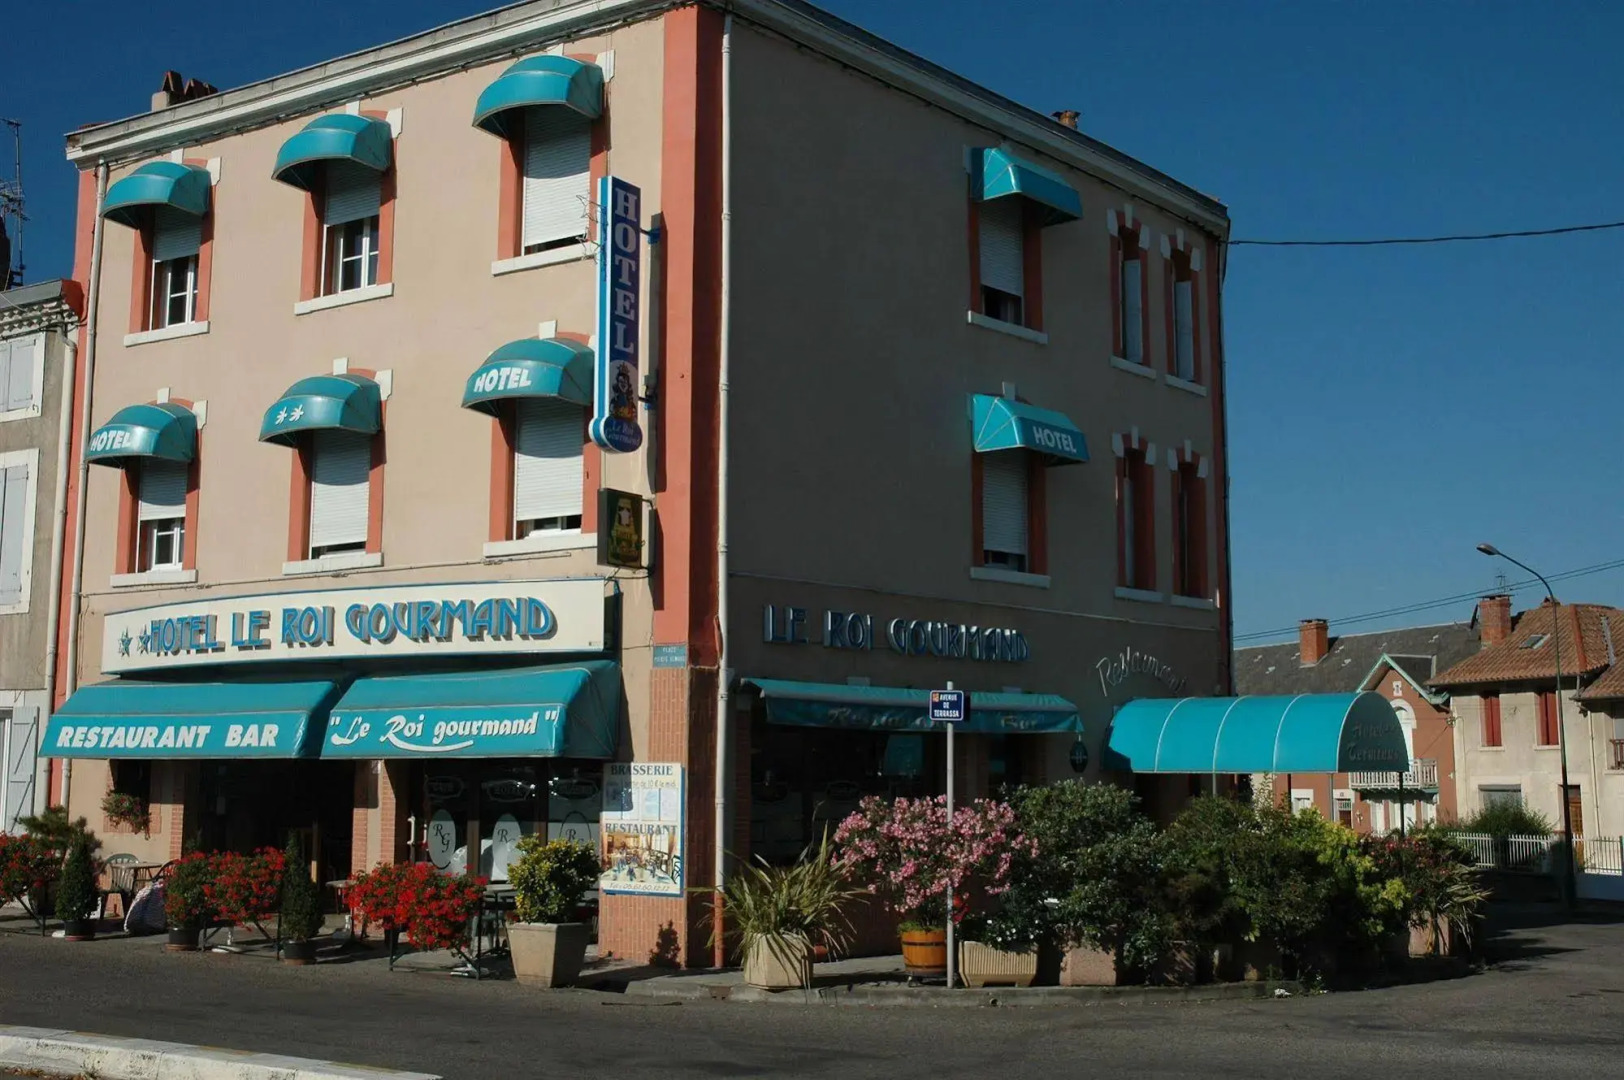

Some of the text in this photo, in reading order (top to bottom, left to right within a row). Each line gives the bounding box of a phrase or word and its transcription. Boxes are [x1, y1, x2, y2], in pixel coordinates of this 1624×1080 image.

[614, 186, 638, 354] HOTEL
[473, 366, 532, 393] HOTEL
[89, 430, 132, 451] HOTEL
[1032, 426, 1077, 453] HOTEL
[150, 597, 556, 656] HOTEL LE ROI GOURMAND
[762, 604, 1030, 662] LE ROI GOURMAND
[934, 709, 960, 717] TERRASSA
[56, 724, 279, 748] RESTAURANT BAR
[611, 764, 673, 776] BRASSERIE
[605, 823, 678, 835] RESTAURANT
